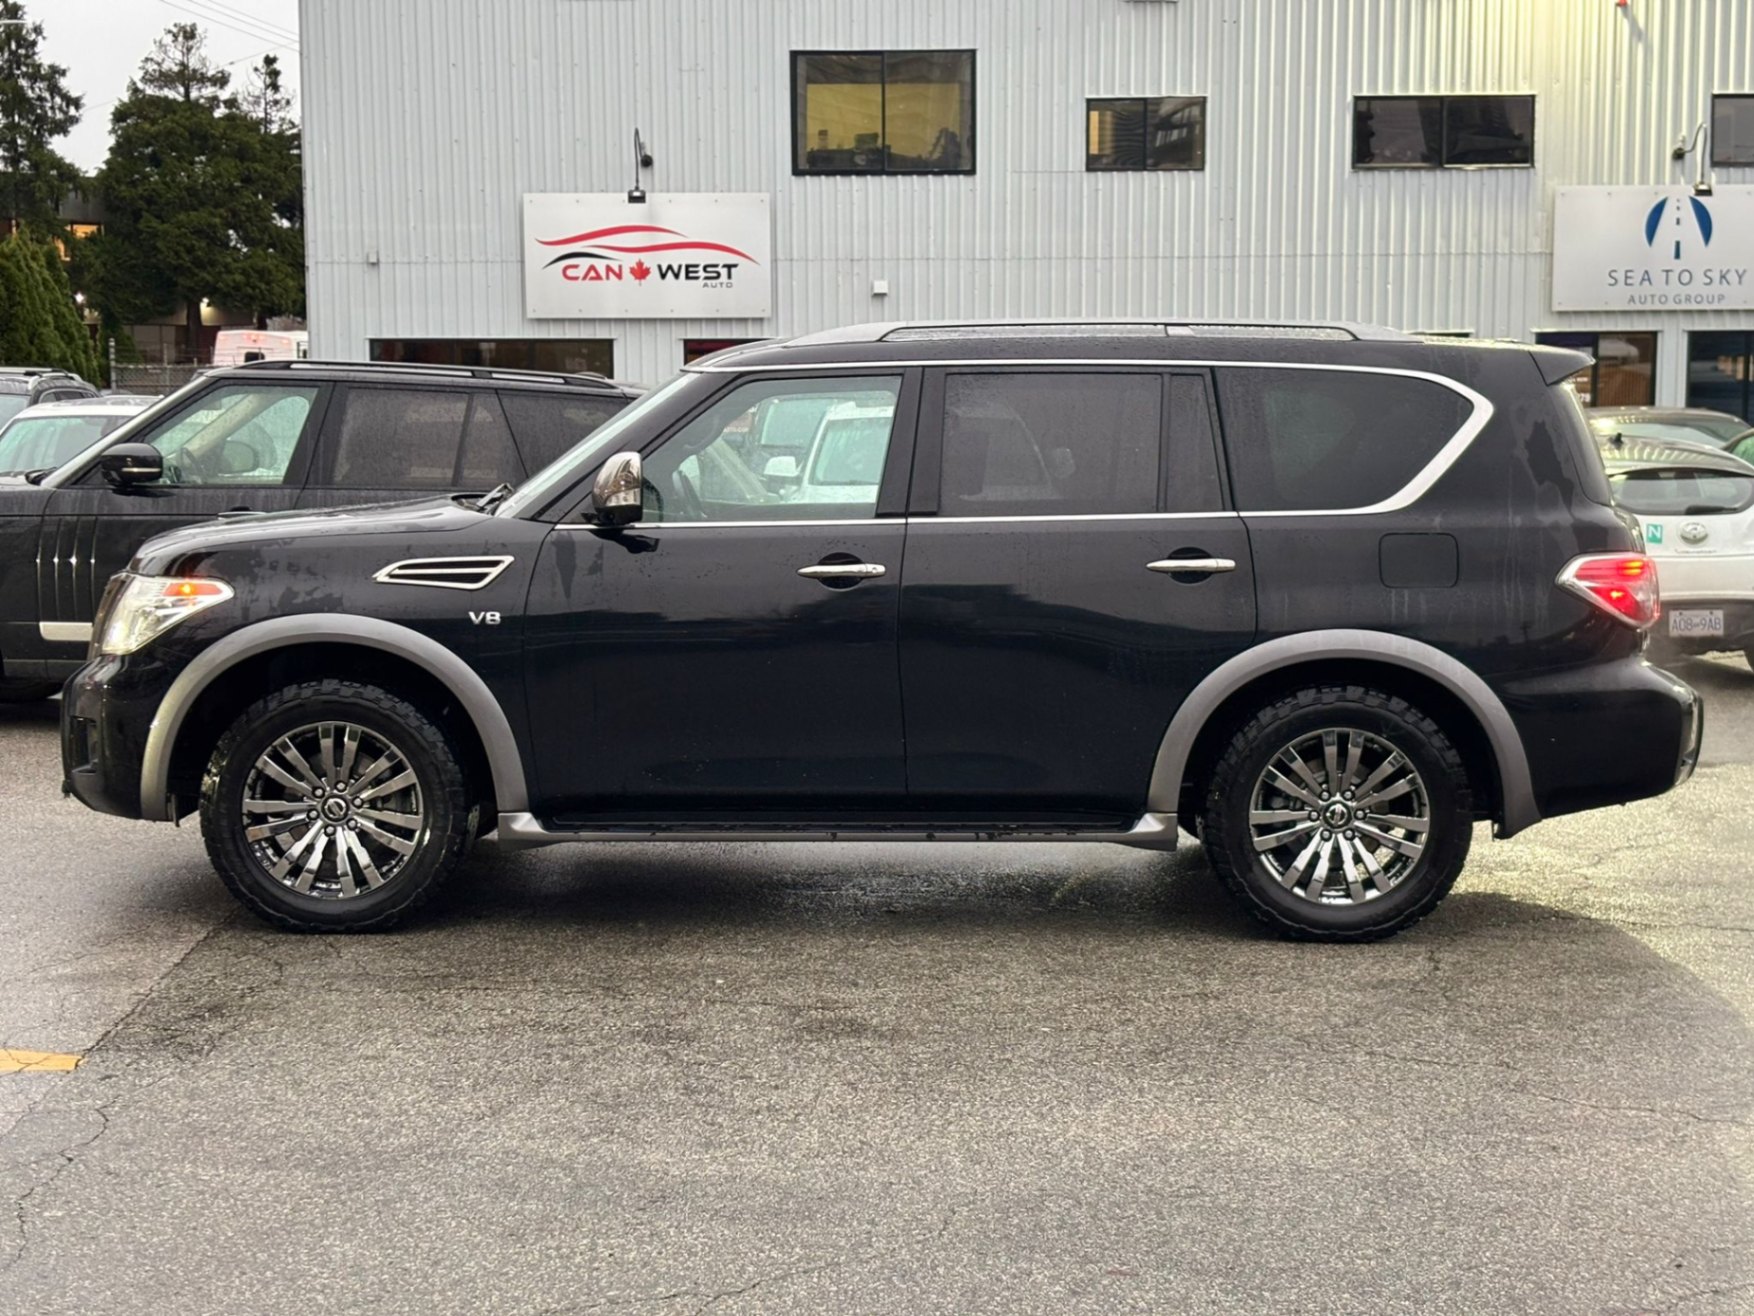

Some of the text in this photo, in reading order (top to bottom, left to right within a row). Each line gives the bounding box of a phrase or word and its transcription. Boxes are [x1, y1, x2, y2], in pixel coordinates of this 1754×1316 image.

[562, 263, 739, 281] CAN WEST
[1608, 268, 1747, 286] SEA TO SKY
[1627, 294, 1726, 305] AUTO GROUP
[1648, 525, 1661, 539] N
[468, 611, 501, 625] V8
